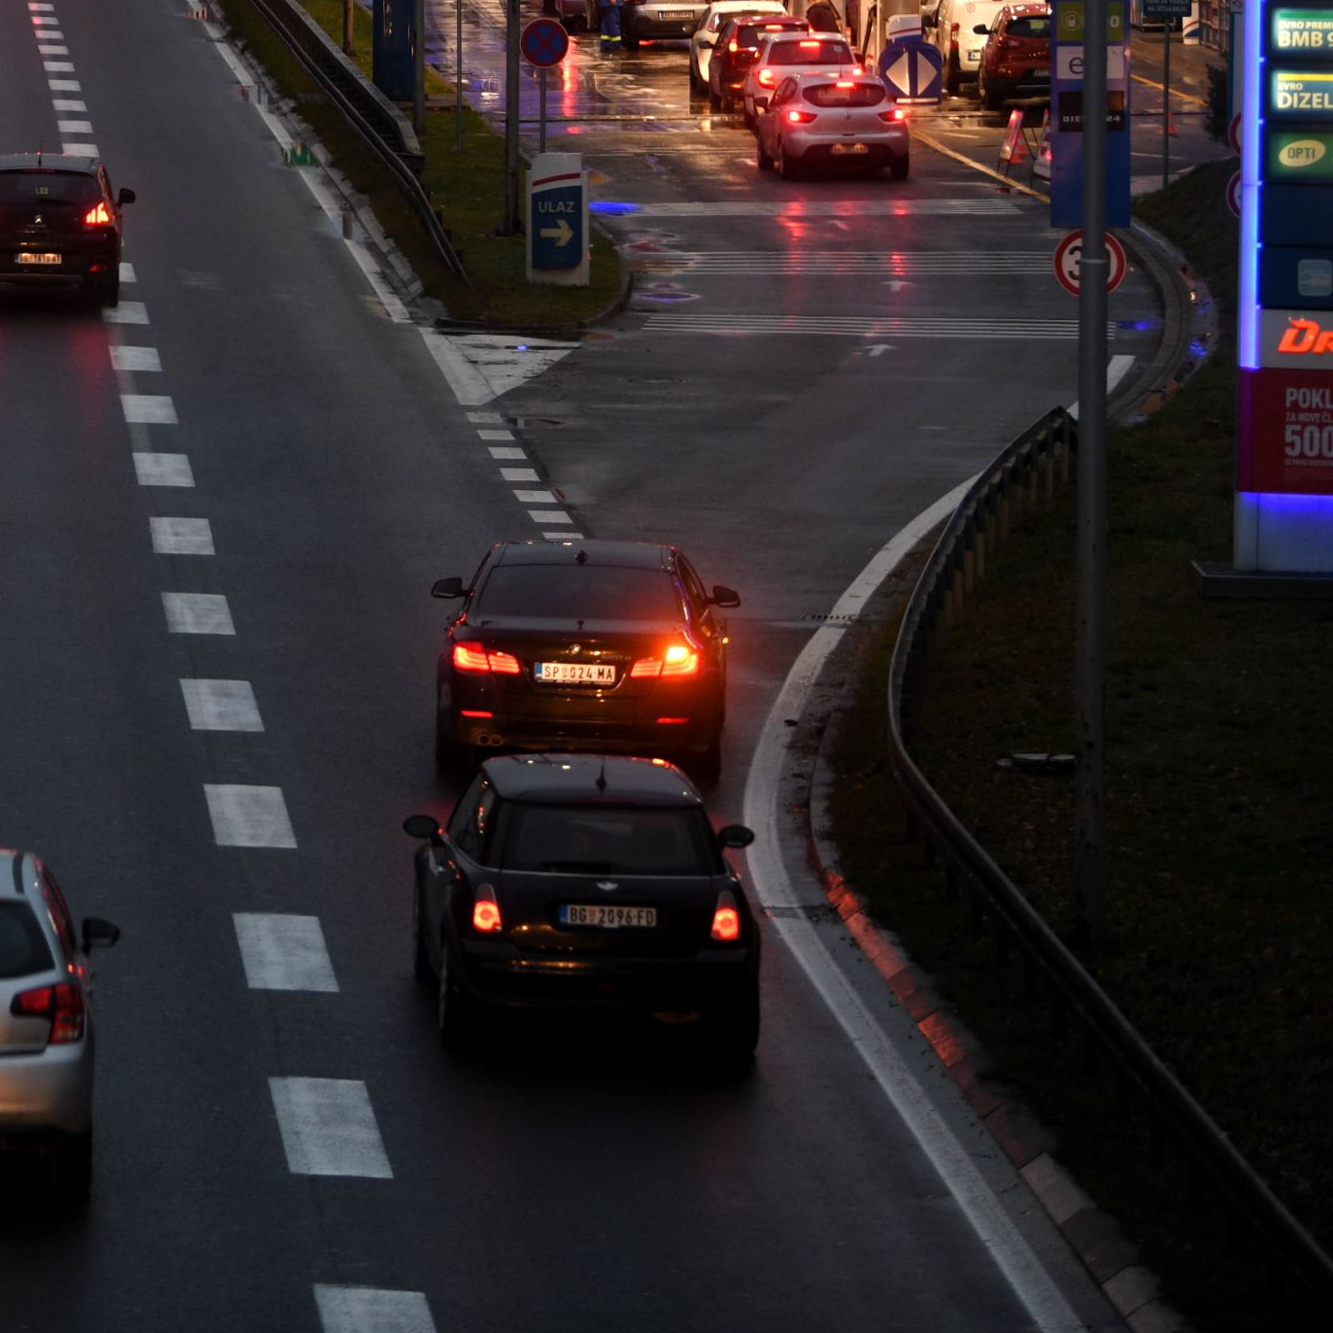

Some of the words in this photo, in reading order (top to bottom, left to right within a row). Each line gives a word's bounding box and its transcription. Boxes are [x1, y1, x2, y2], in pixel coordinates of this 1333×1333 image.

[1278, 31, 1322, 48] BMB
[1278, 93, 1333, 109] DIZEL
[1287, 147, 1316, 160] OPTI
[537, 201, 574, 214] ULAZ
[1285, 387, 1333, 409] POKL
[1285, 412, 1297, 422] ZA
[1298, 412, 1319, 423] NOVE
[1284, 425, 1333, 458] 500
[544, 666, 560, 679] SP
[569, 906, 588, 923] BG
